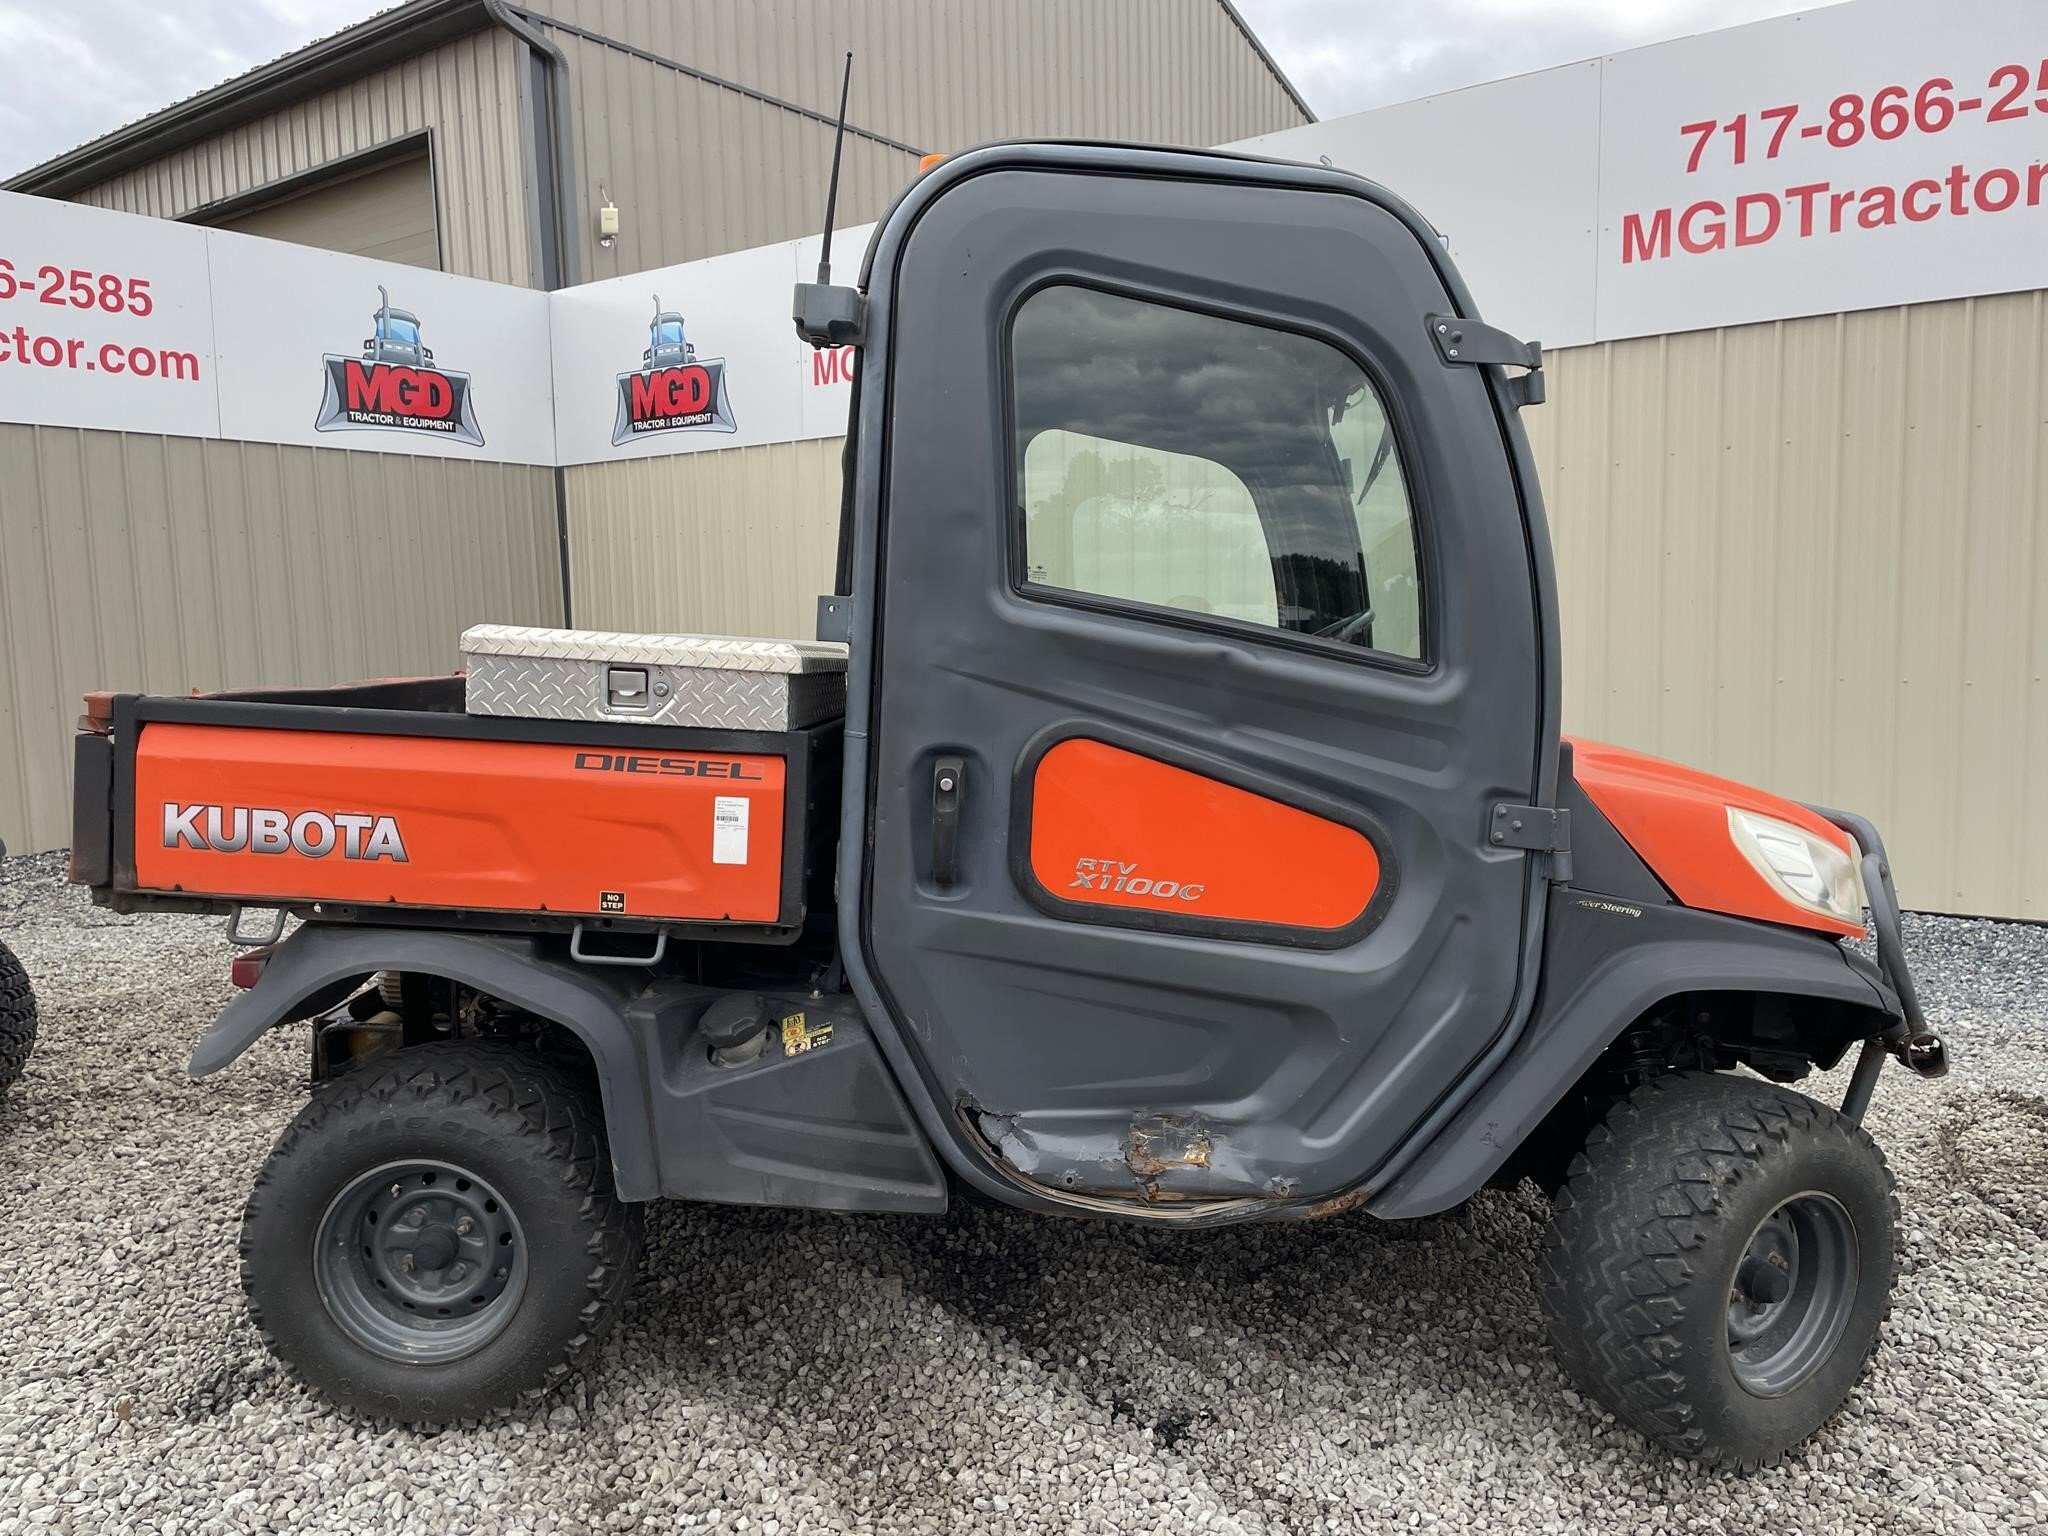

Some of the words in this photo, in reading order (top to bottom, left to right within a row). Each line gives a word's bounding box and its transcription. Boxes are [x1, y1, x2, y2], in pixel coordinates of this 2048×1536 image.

[345, 360, 453, 418] MGD
[631, 365, 711, 420] MGD
[349, 410, 394, 427] TRACTOR
[395, 416, 402, 425] &
[403, 417, 454, 431] EQUIPMENT
[633, 418, 666, 431] TRACTOR
[671, 412, 712, 427] EQUIPMENT
[575, 753, 762, 780] DIESEL
[163, 802, 409, 862] KUBOTA
[1076, 857, 1138, 875] RTV
[1069, 871, 1205, 901] X1100C
[601, 901, 623, 909] STEP
[607, 894, 619, 902] NO
[1600, 902, 1642, 917] Steering
